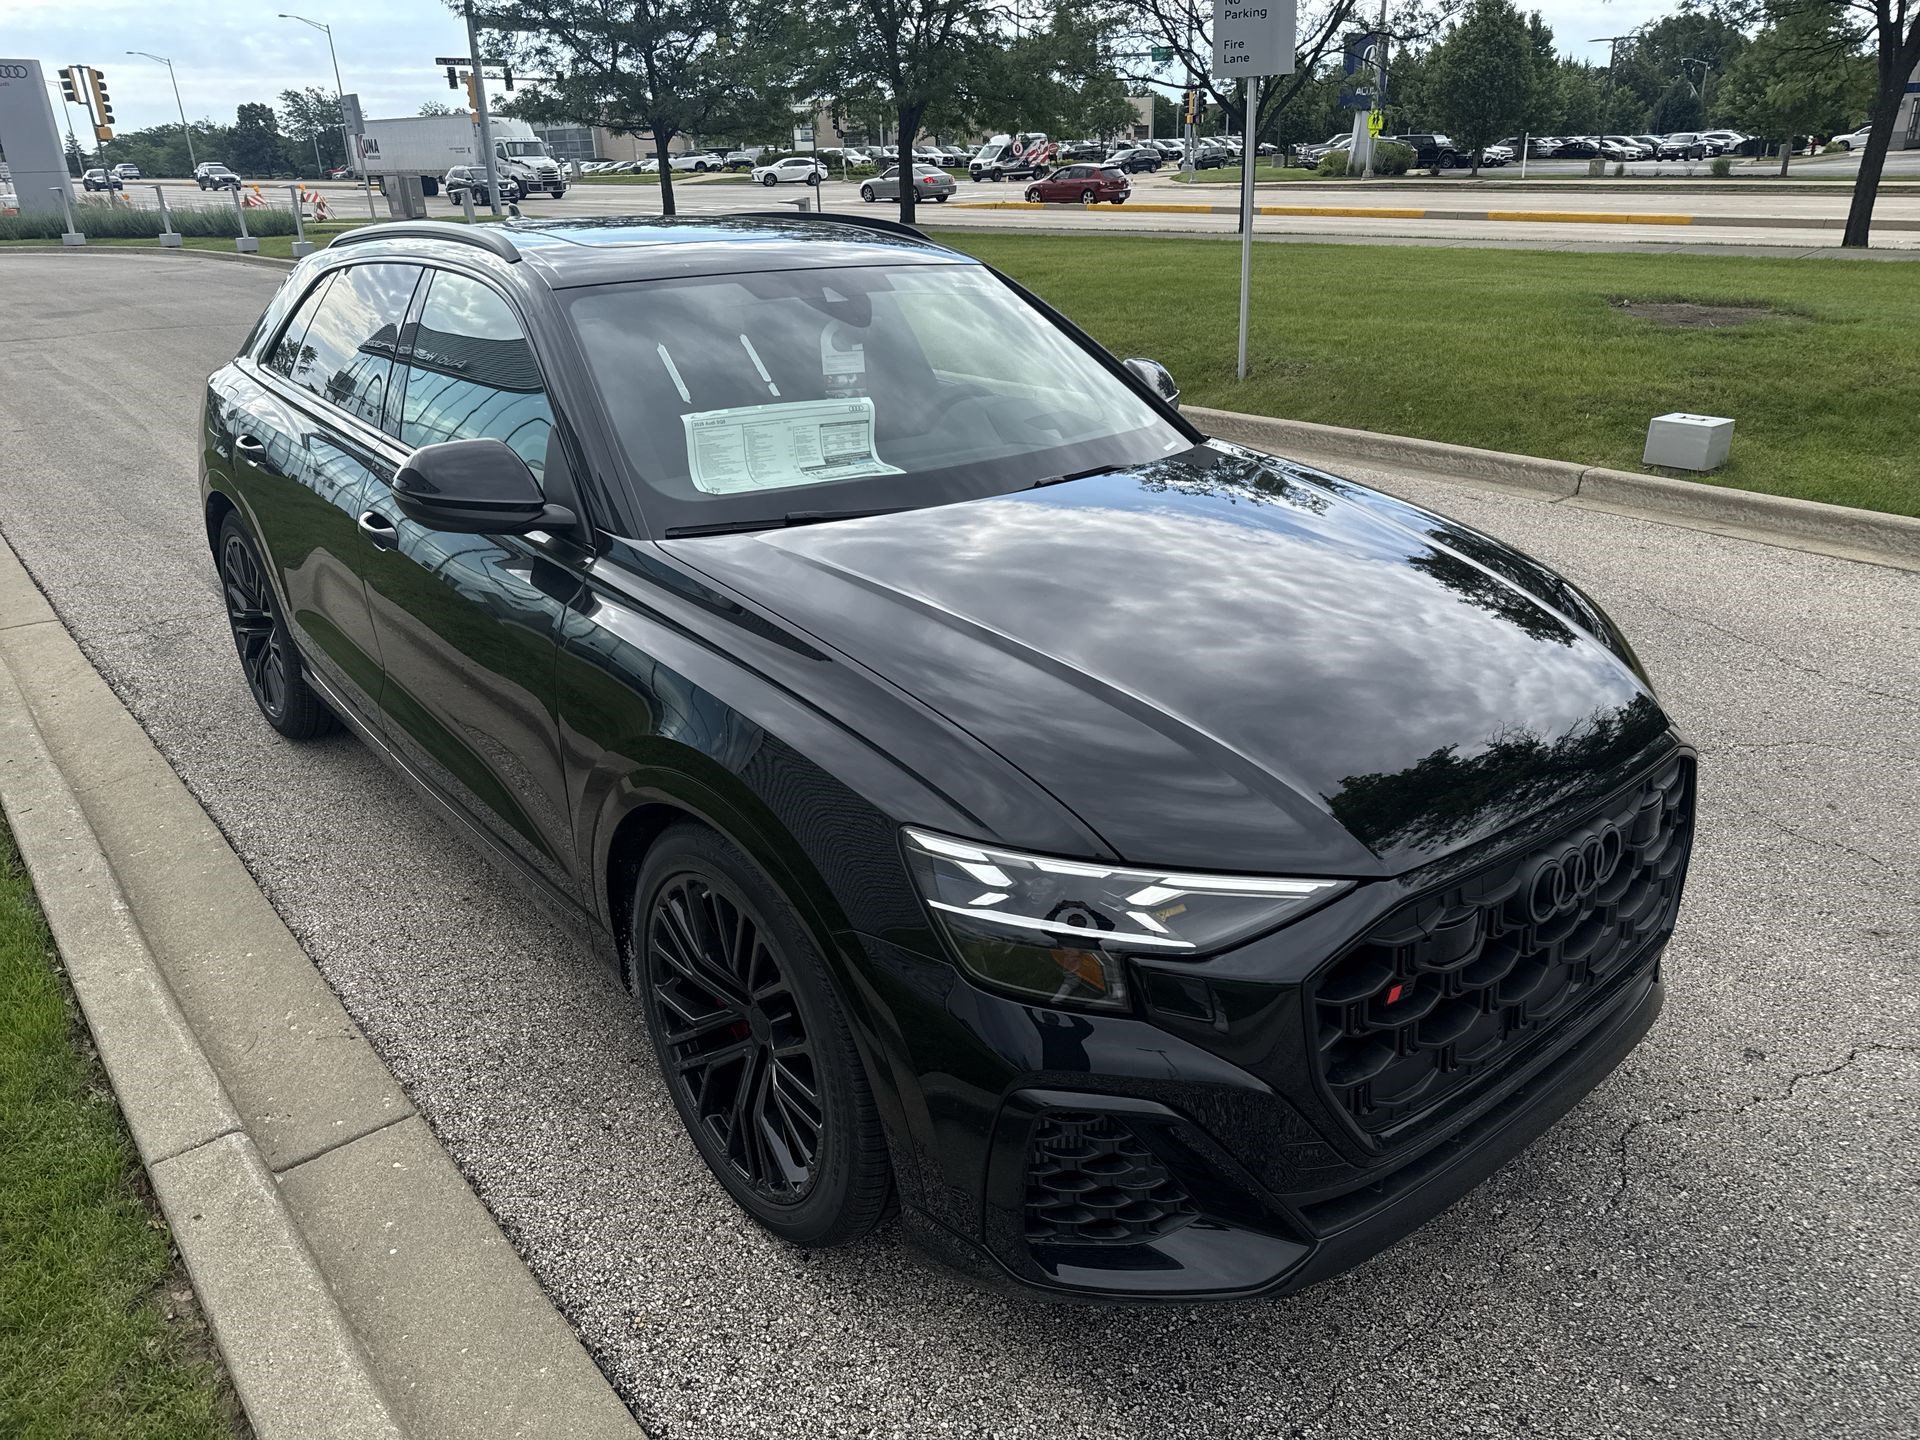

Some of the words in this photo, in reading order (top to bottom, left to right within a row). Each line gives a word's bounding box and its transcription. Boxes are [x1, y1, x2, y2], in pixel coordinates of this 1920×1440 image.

[1224, 8, 1267, 20] Parking
[1224, 40, 1245, 49] Fire
[1223, 54, 1250, 64] Lane
